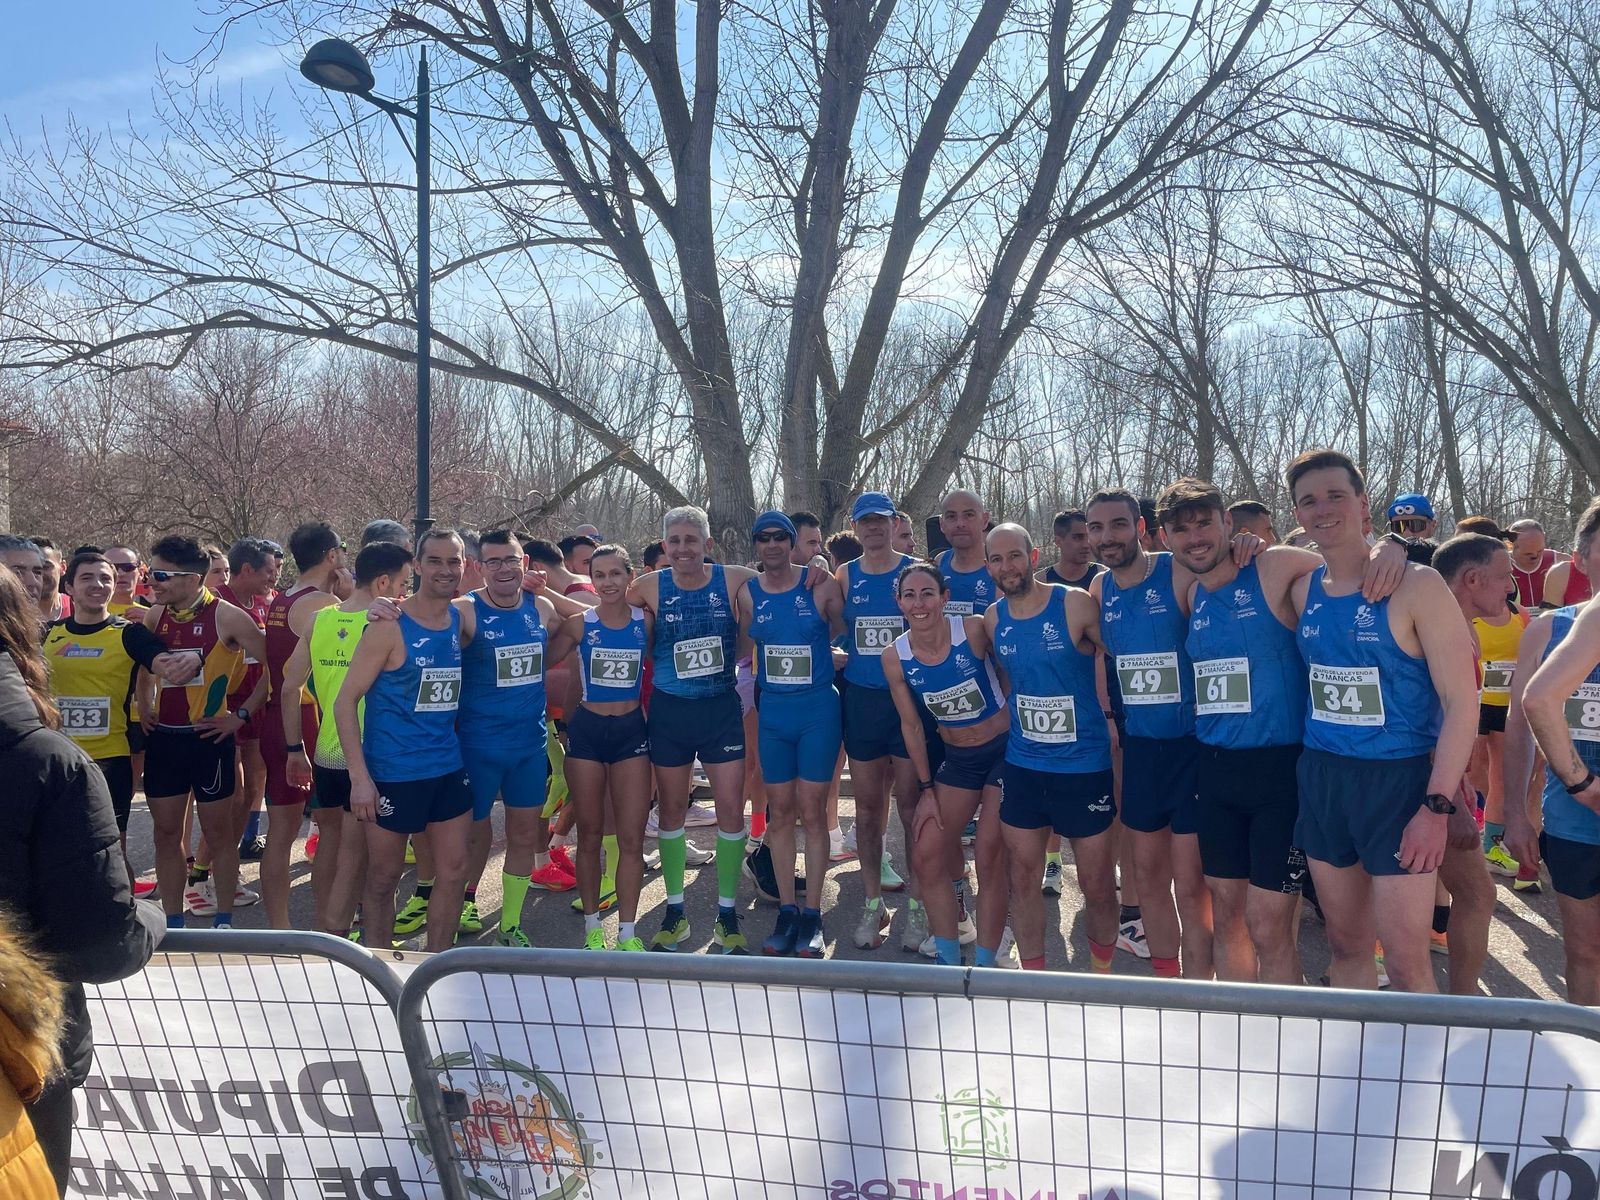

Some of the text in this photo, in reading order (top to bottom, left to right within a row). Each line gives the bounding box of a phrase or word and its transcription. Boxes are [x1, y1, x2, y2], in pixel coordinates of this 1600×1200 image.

[864, 628, 892, 646] 80
[510, 656, 533, 677] 87
[685, 650, 712, 669] 20
[780, 658, 793, 675] 9
[602, 660, 630, 680] 23
[1326, 674, 1363, 682] MANCAS
[1502, 670, 1512, 686] 7
[1130, 670, 1162, 692] 49
[1206, 676, 1228, 702] 61
[430, 682, 453, 702] 36
[1324, 684, 1362, 712] 34
[941, 696, 972, 715] 24
[61, 708, 101, 727] 133
[1024, 710, 1068, 732] 102
